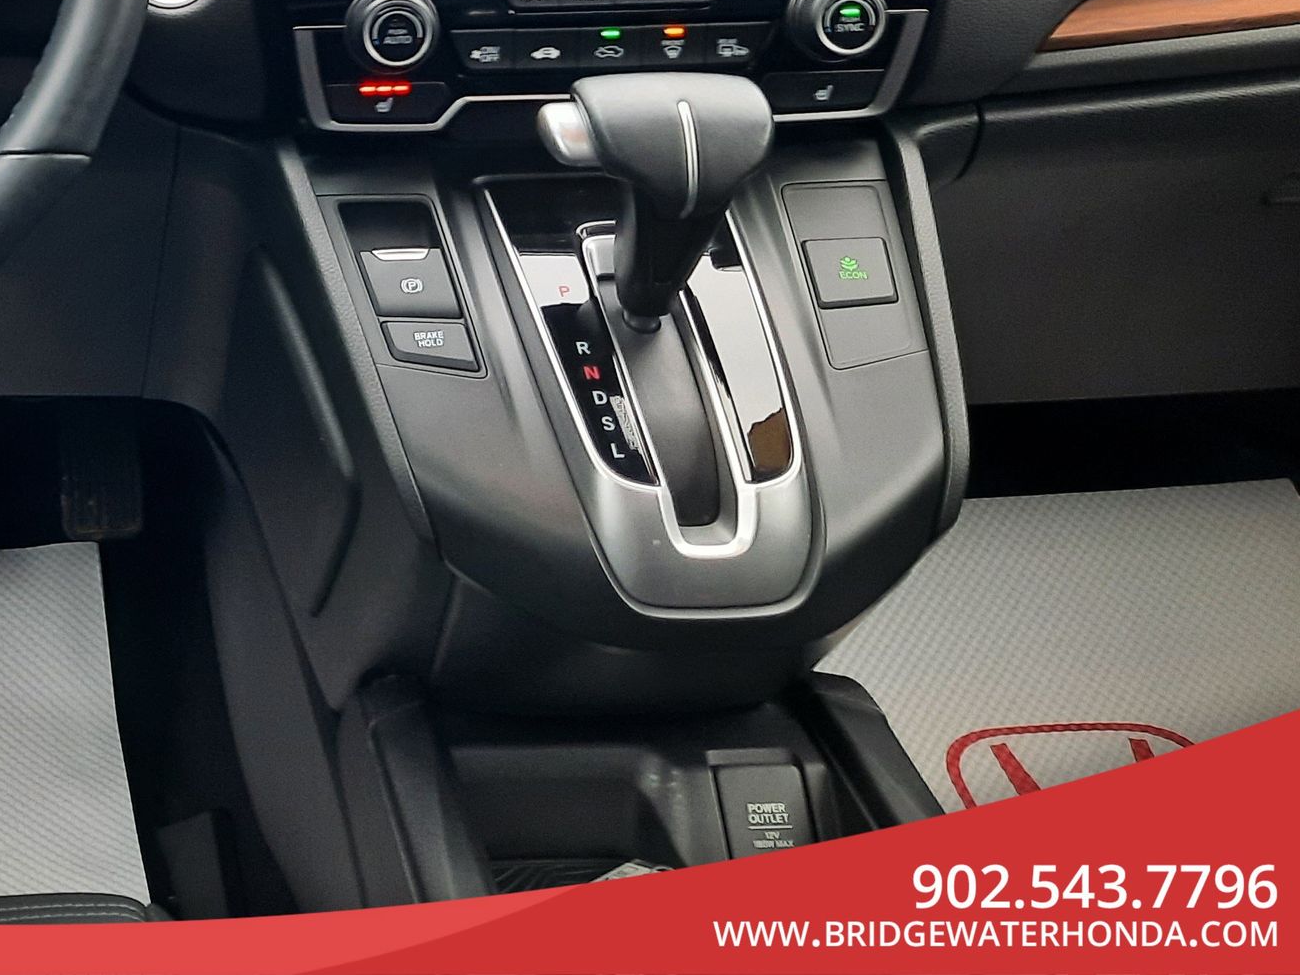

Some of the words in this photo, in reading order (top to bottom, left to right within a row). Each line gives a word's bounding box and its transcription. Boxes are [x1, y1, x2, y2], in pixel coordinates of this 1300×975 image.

[839, 271, 868, 280] ECON
[558, 285, 570, 297] P
[414, 330, 444, 340] BRAKE
[418, 338, 444, 348] HOLD
[575, 341, 591, 355] R
[583, 365, 600, 380] N
[592, 390, 608, 405] D
[601, 416, 616, 431] S
[610, 443, 625, 458] L
[746, 803, 786, 813] POWER
[748, 813, 788, 824] OUTLET
